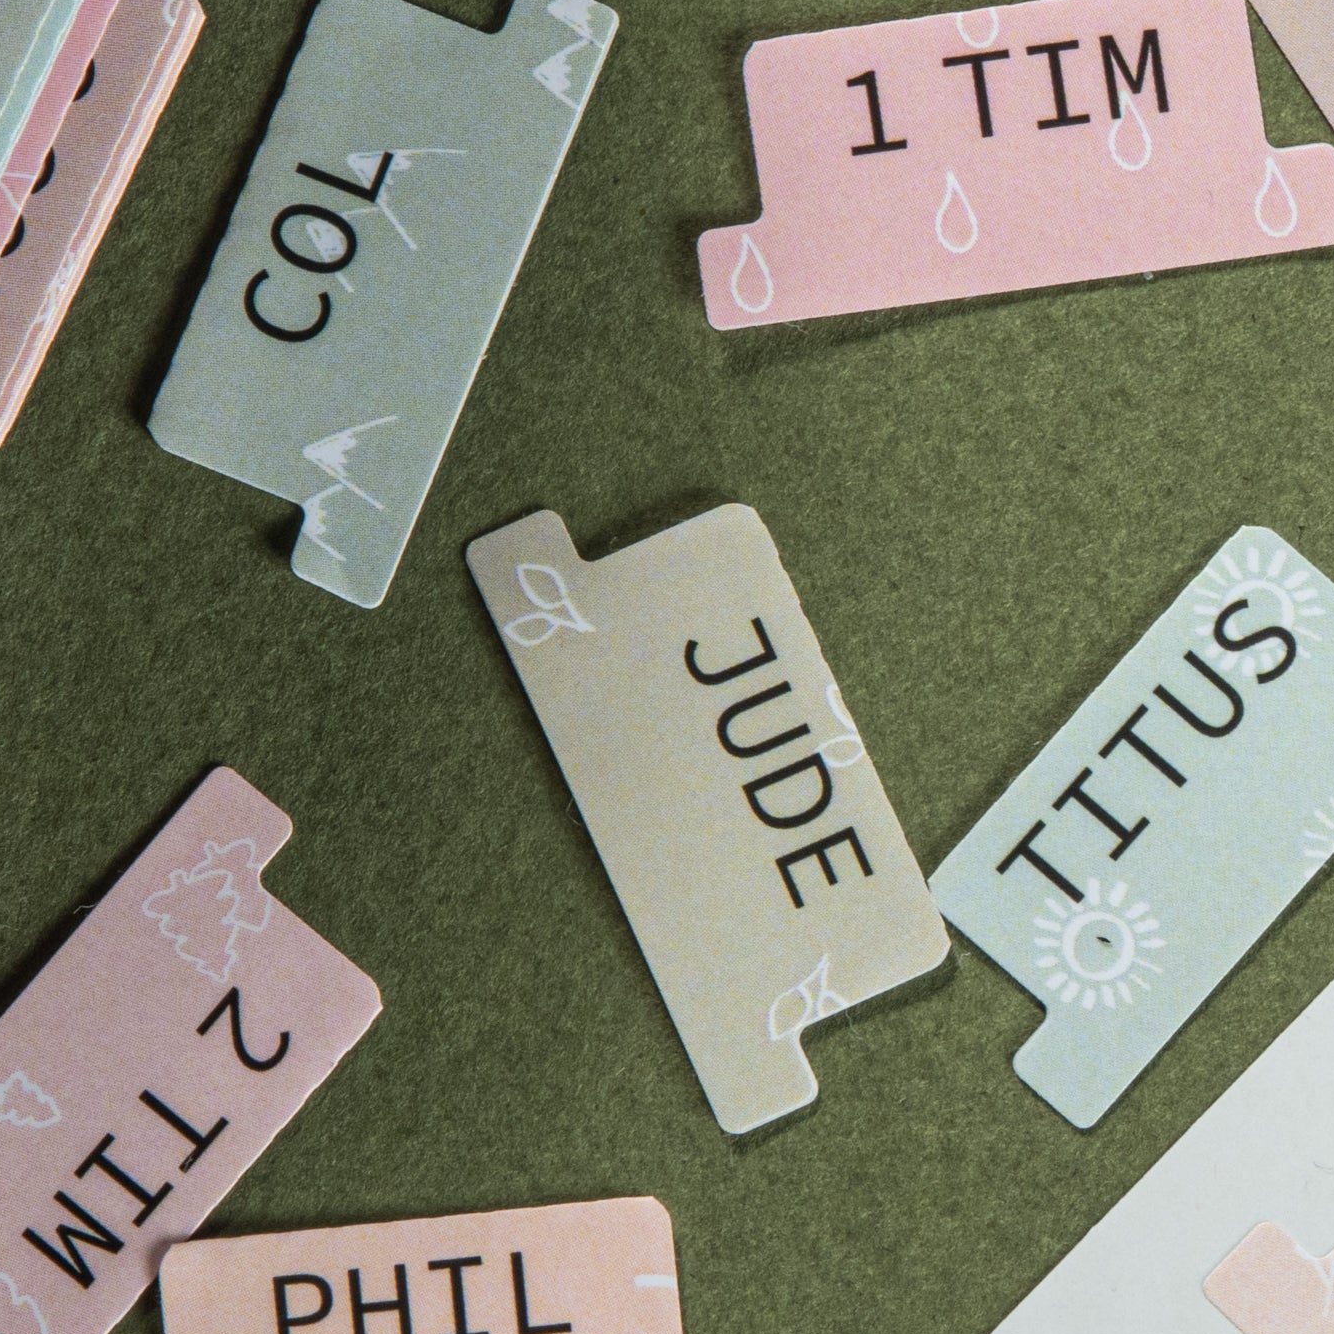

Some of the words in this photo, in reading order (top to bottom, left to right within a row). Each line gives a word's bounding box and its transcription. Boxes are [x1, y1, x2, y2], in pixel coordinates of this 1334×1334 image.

[846, 70, 908, 157] 1
[942, 28, 1170, 138] TIM
[243, 151, 394, 344] COL
[684, 617, 874, 909] JUDE
[996, 599, 1297, 903] TITUS
[195, 986, 291, 1073] 2
[21, 1089, 230, 1290] TIM
